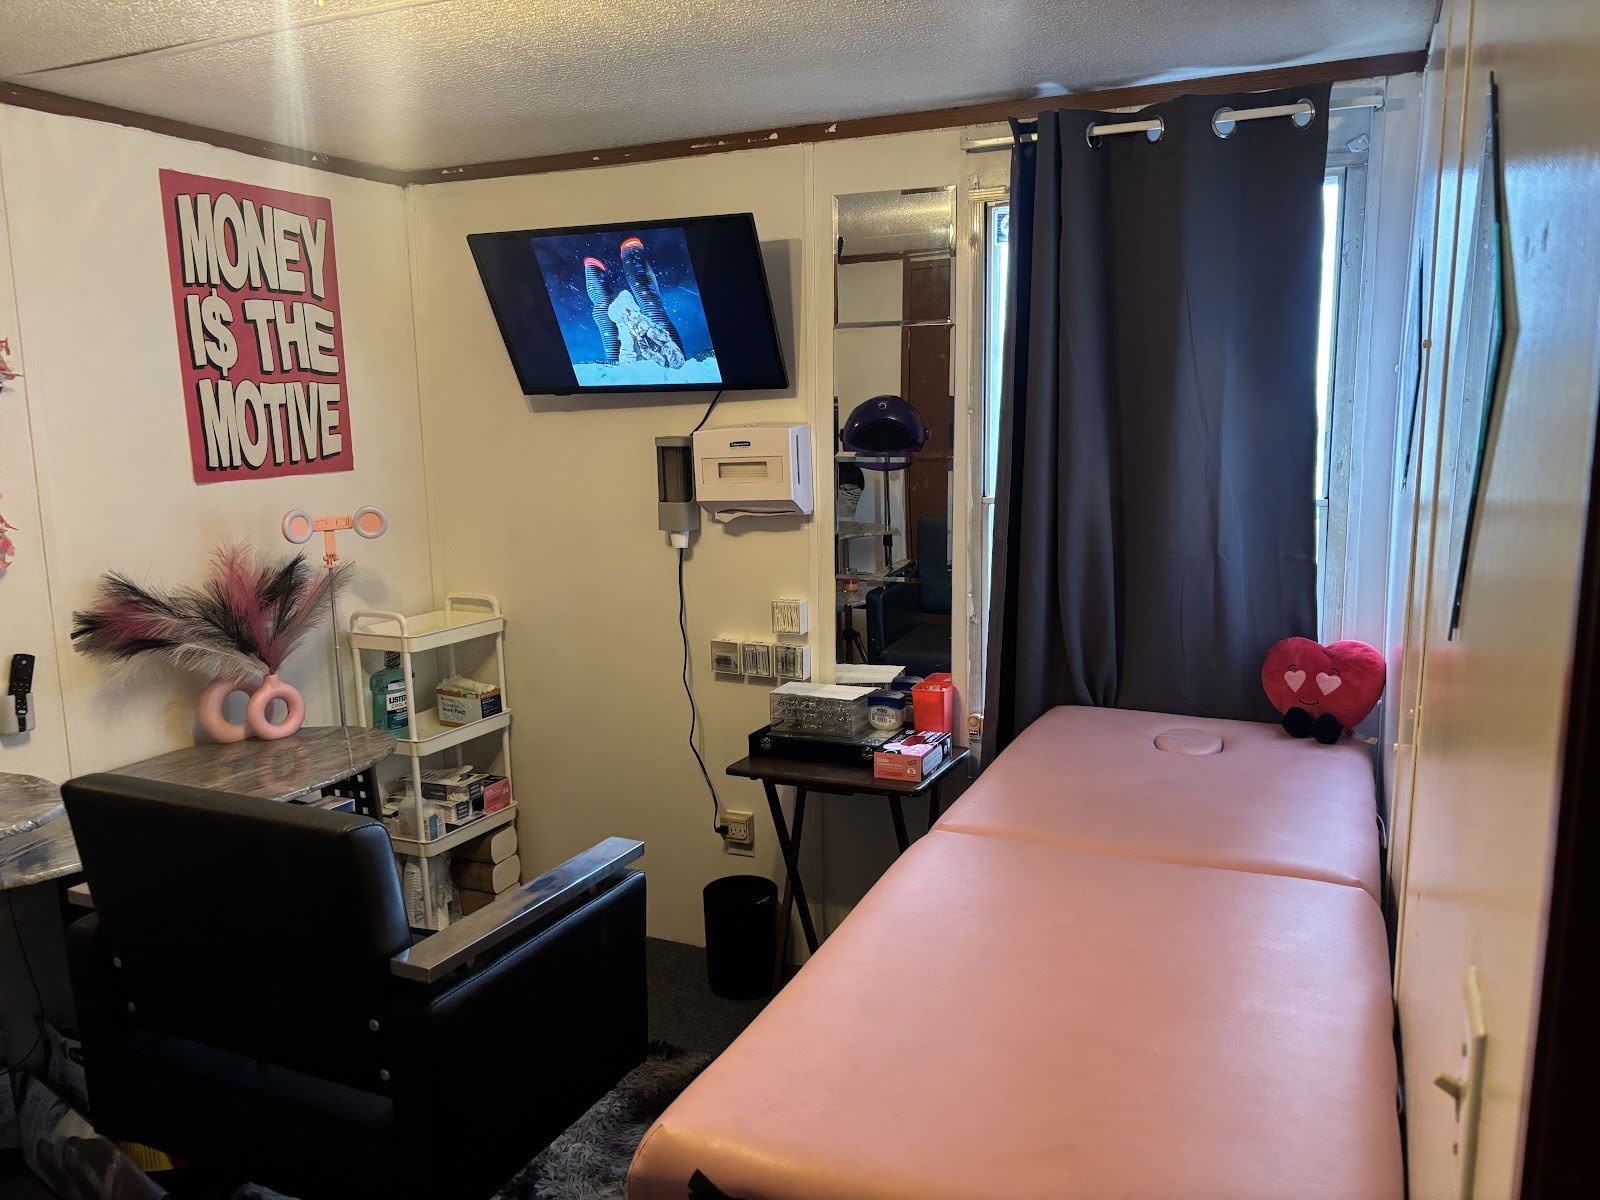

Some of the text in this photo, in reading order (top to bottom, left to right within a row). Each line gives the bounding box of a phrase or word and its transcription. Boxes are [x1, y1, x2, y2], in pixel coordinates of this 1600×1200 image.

[174, 192, 327, 300] MONEY
[243, 299, 340, 374] THE
[197, 379, 342, 471] MOTIVE
